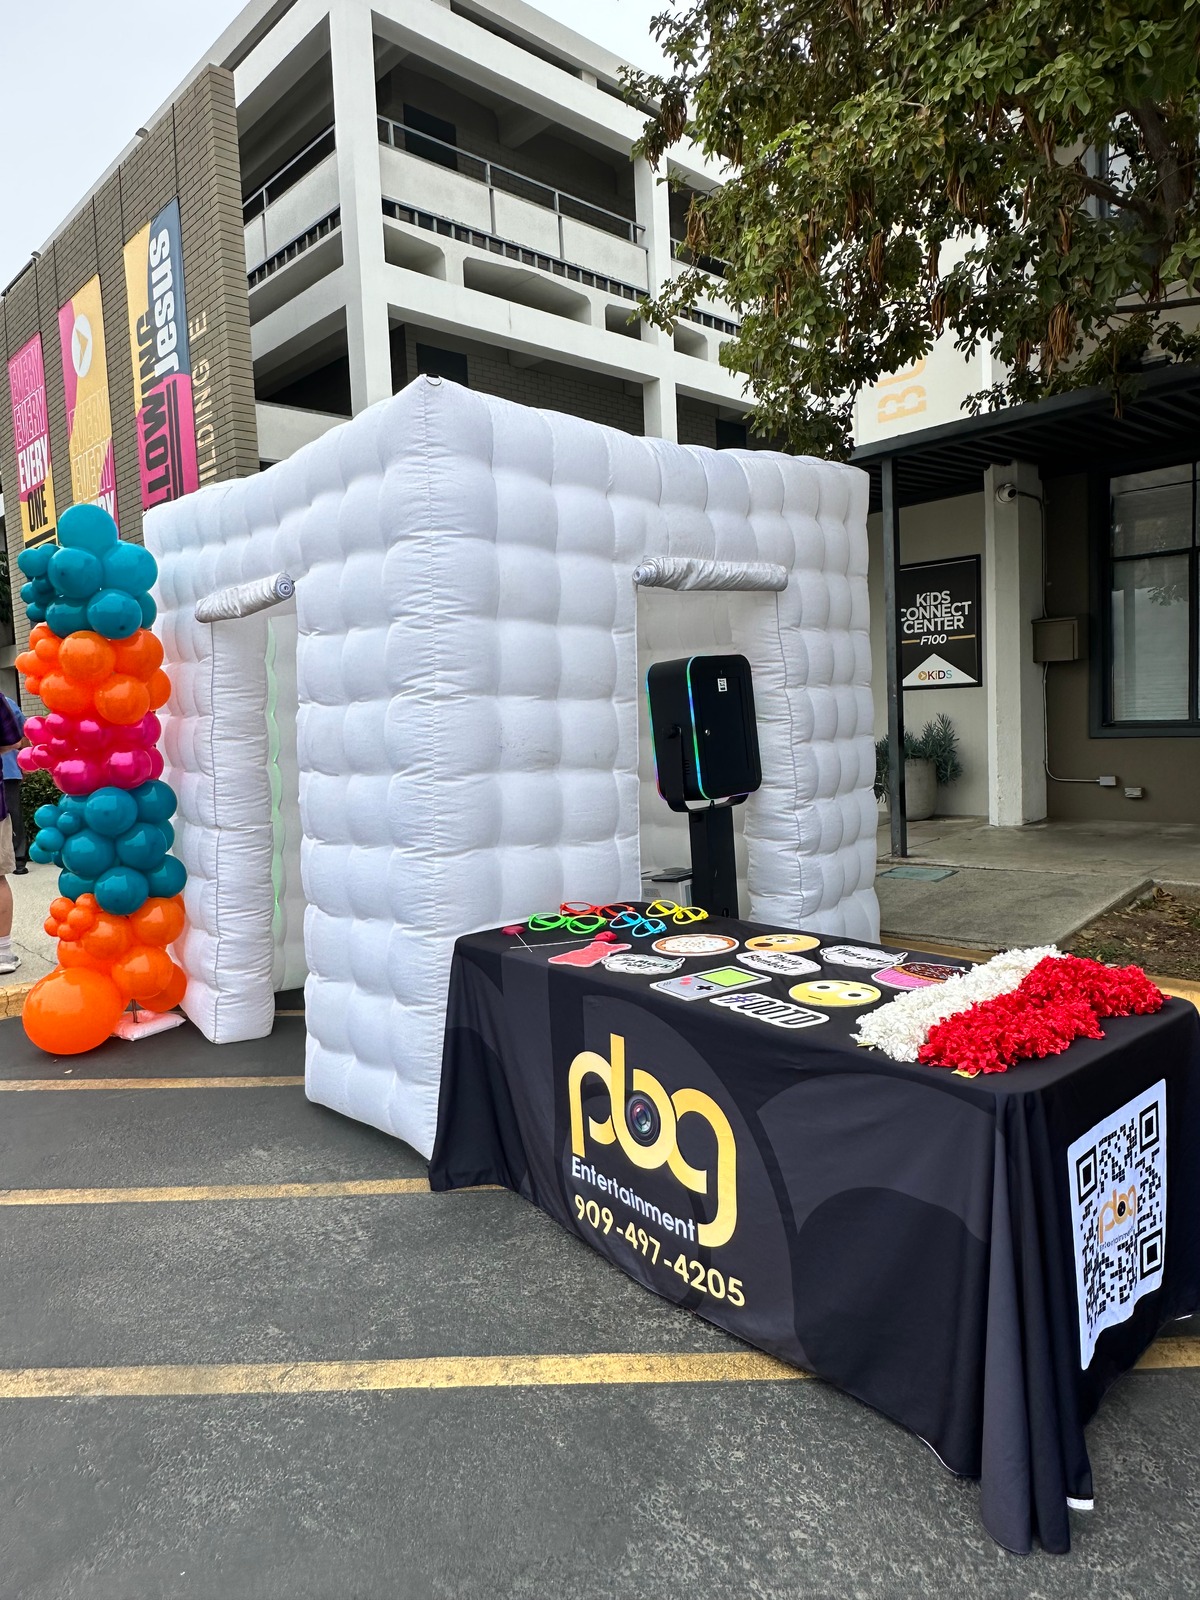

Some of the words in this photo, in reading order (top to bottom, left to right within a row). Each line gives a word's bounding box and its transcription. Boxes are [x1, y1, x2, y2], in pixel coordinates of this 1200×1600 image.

[14, 386, 46, 450] EVERY
[18, 433, 49, 492] EVERY
[27, 483, 48, 533] ONE
[903, 616, 965, 634] CENTER
[920, 633, 947, 646] F100
[717, 994, 823, 1026] #OOTD
[571, 1155, 696, 1242] Entertainment
[574, 1194, 746, 1307] 909-497-4205
